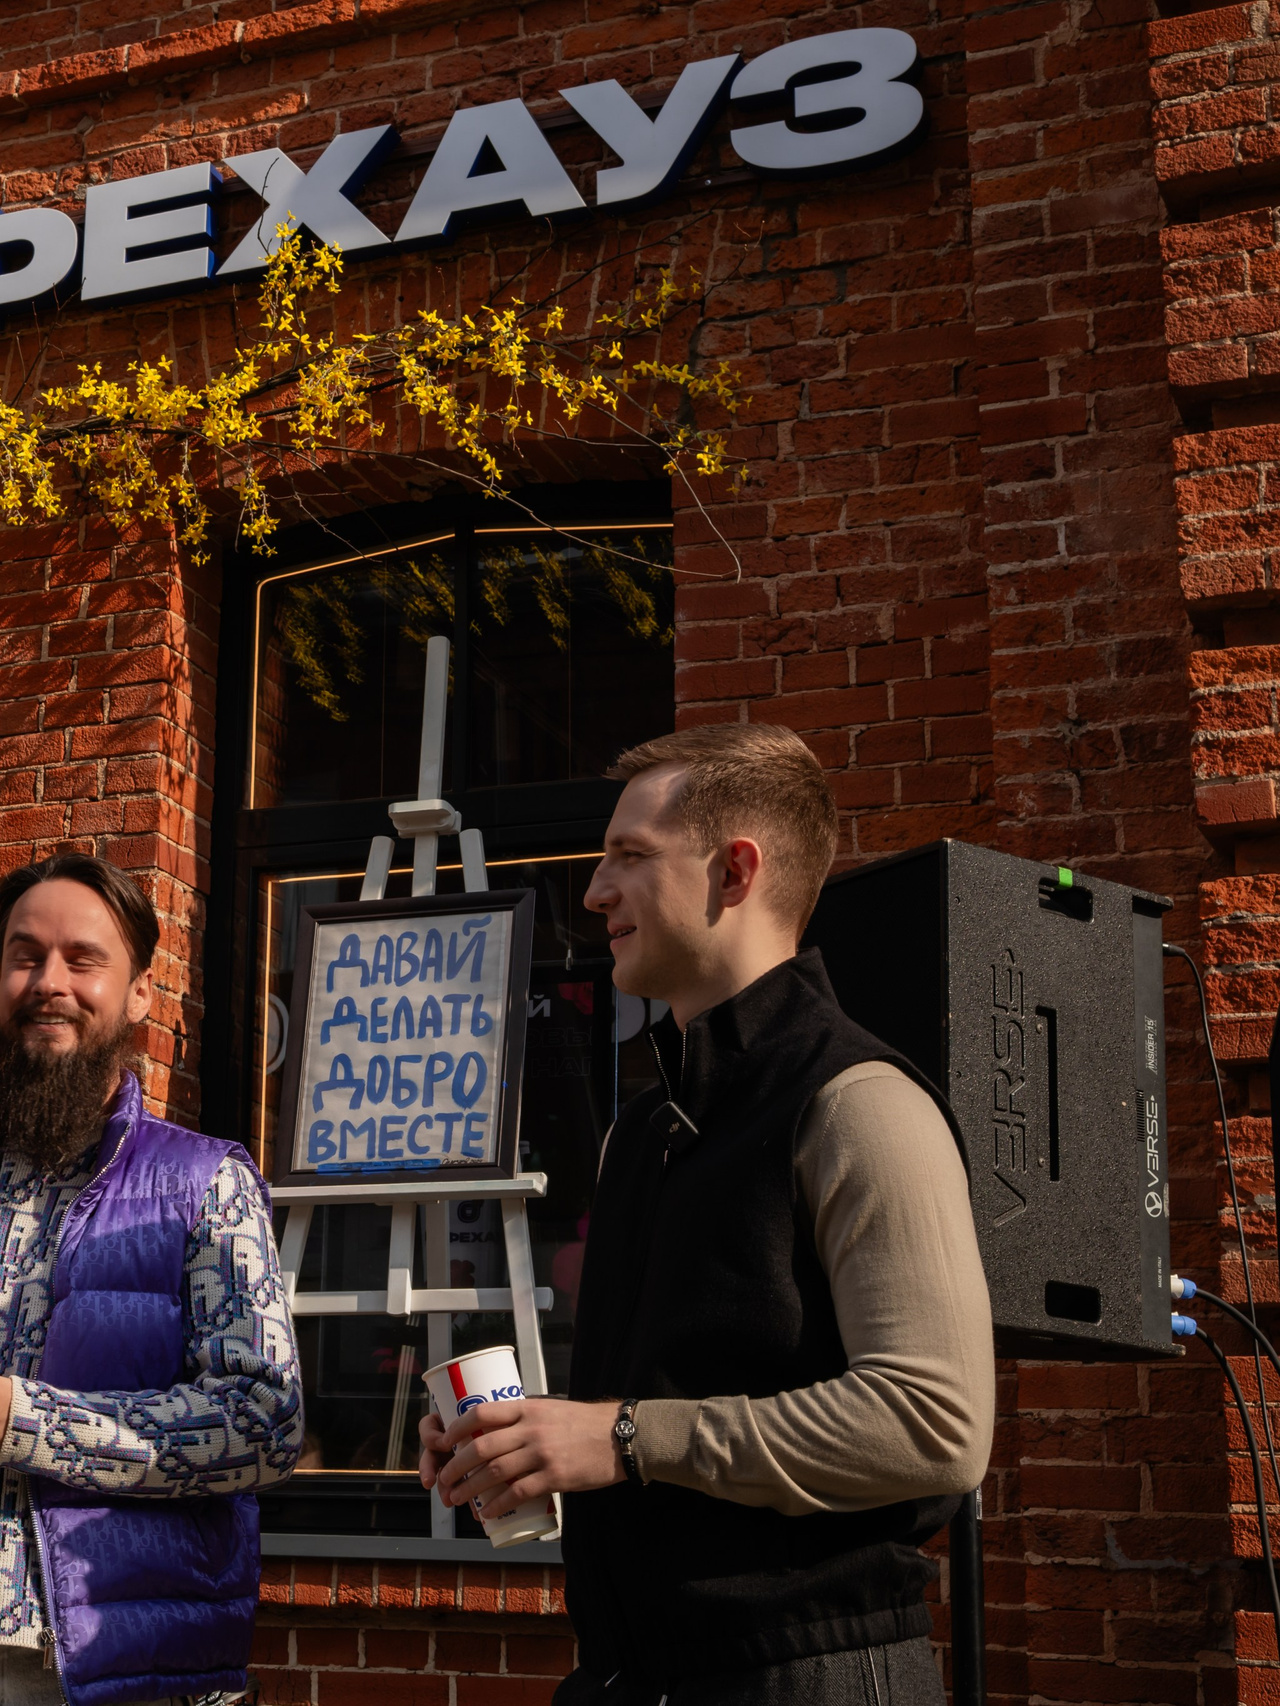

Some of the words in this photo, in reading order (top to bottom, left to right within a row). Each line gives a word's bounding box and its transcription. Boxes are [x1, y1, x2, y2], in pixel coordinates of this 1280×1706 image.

[326, 914, 493, 993] ДАВАЙ
[320, 993, 494, 1046] ДЕЛАТЬ
[312, 1051, 488, 1113] ДОБРО
[307, 1111, 489, 1164] ВМЕСТЕ
